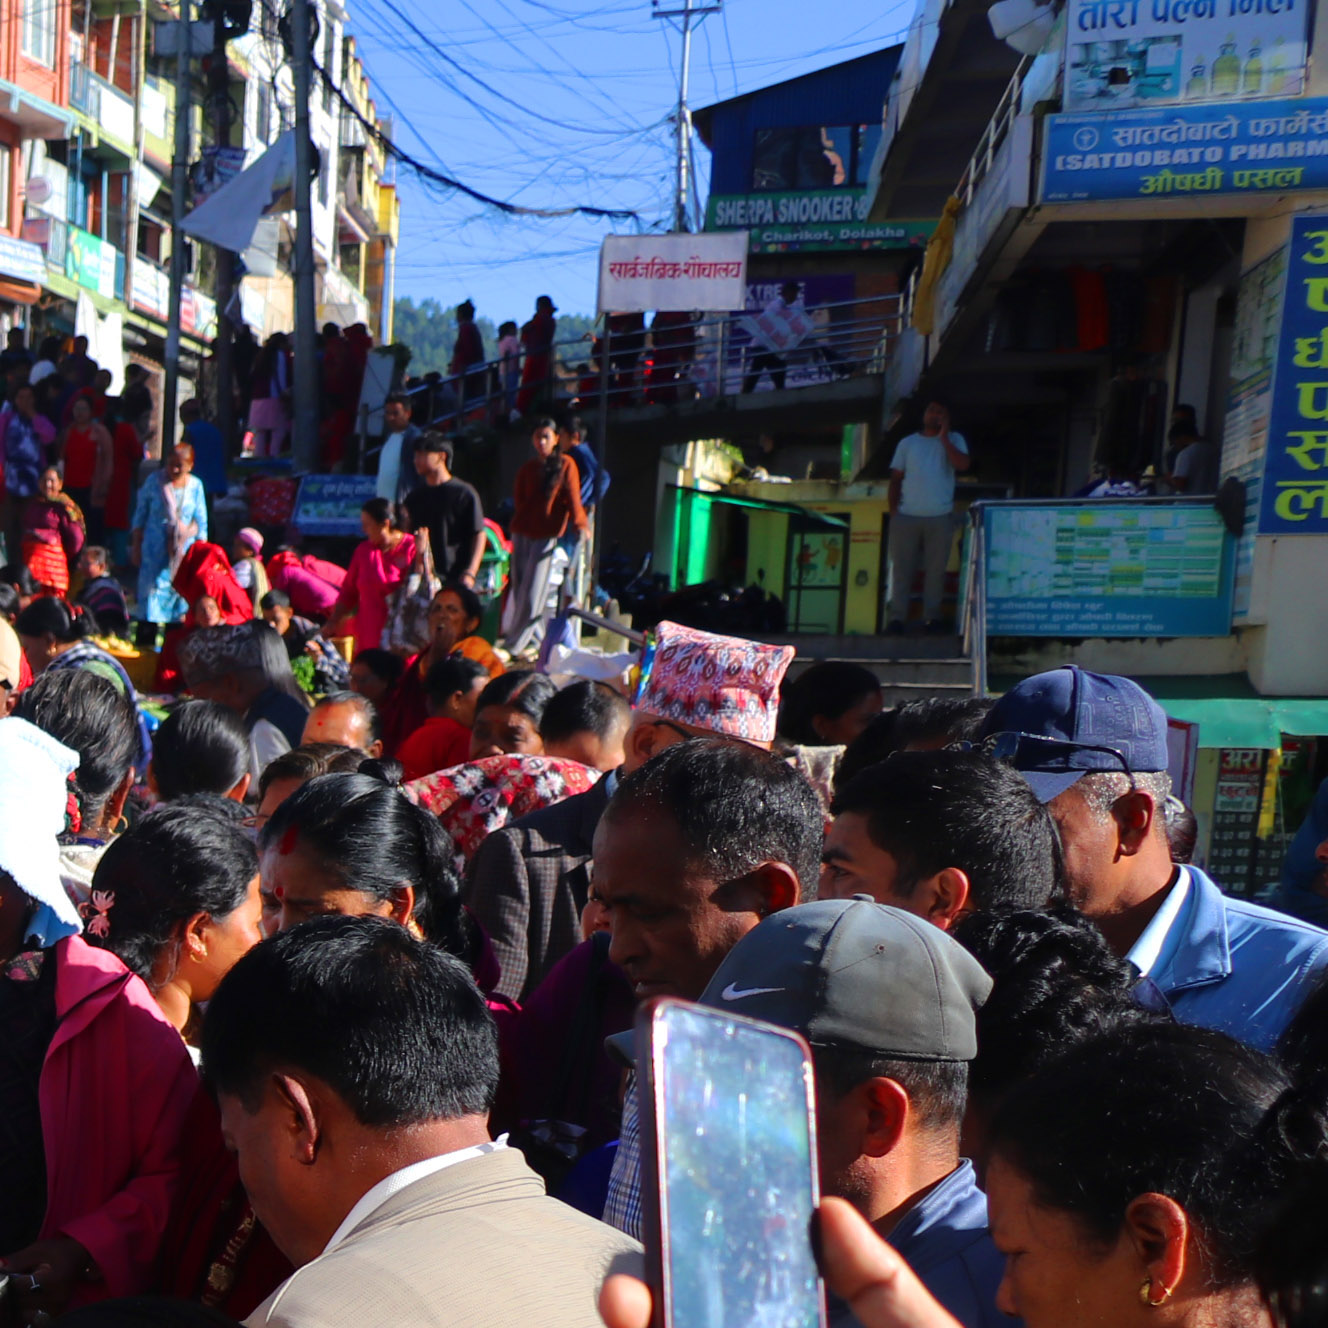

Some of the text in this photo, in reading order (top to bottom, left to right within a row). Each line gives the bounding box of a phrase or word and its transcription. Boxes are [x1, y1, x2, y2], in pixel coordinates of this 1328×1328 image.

[1140, 167, 1305, 194] औषधी पसल
[715, 198, 775, 227] SHERPA
[778, 196, 853, 224] SNOOKER
[762, 228, 906, 242] Charikot, Dolakha
[744, 281, 806, 302] XTREE
